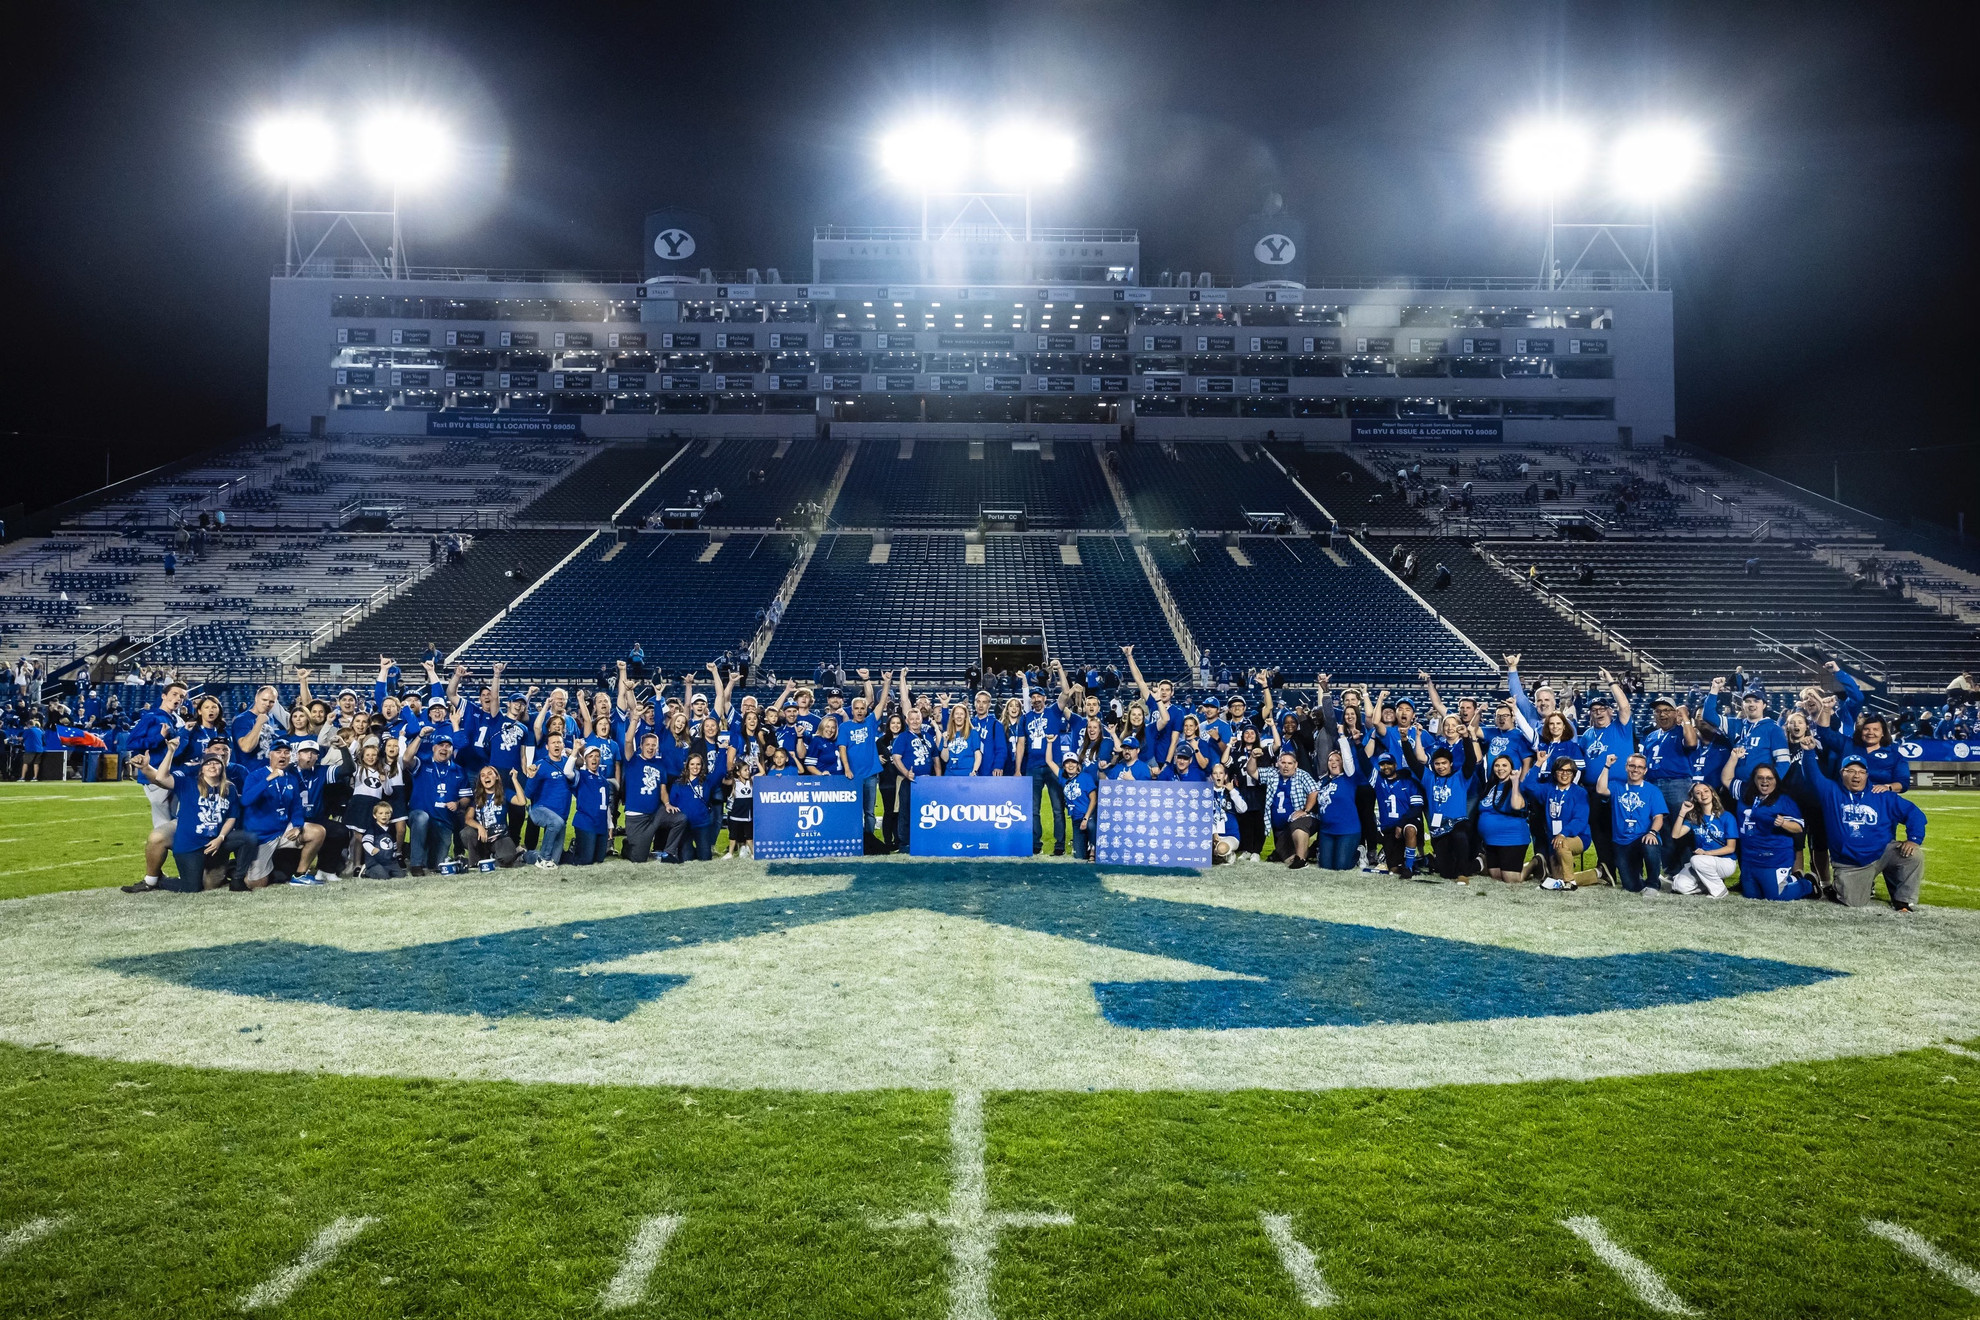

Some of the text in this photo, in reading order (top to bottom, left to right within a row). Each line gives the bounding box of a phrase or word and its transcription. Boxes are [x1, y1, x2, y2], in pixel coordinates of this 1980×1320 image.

[660, 232, 689, 256] Y
[1262, 238, 1289, 261] Y
[474, 726, 488, 748] 1
[1903, 745, 1918, 756] Y
[300, 791, 308, 806] 1
[599, 787, 607, 810] 1
[760, 791, 857, 803] WELCOME WINNERS
[1277, 792, 1286, 813] 1
[1388, 794, 1399, 818] 1
[798, 805, 824, 830] 50
[919, 800, 1027, 829] go cougs.
